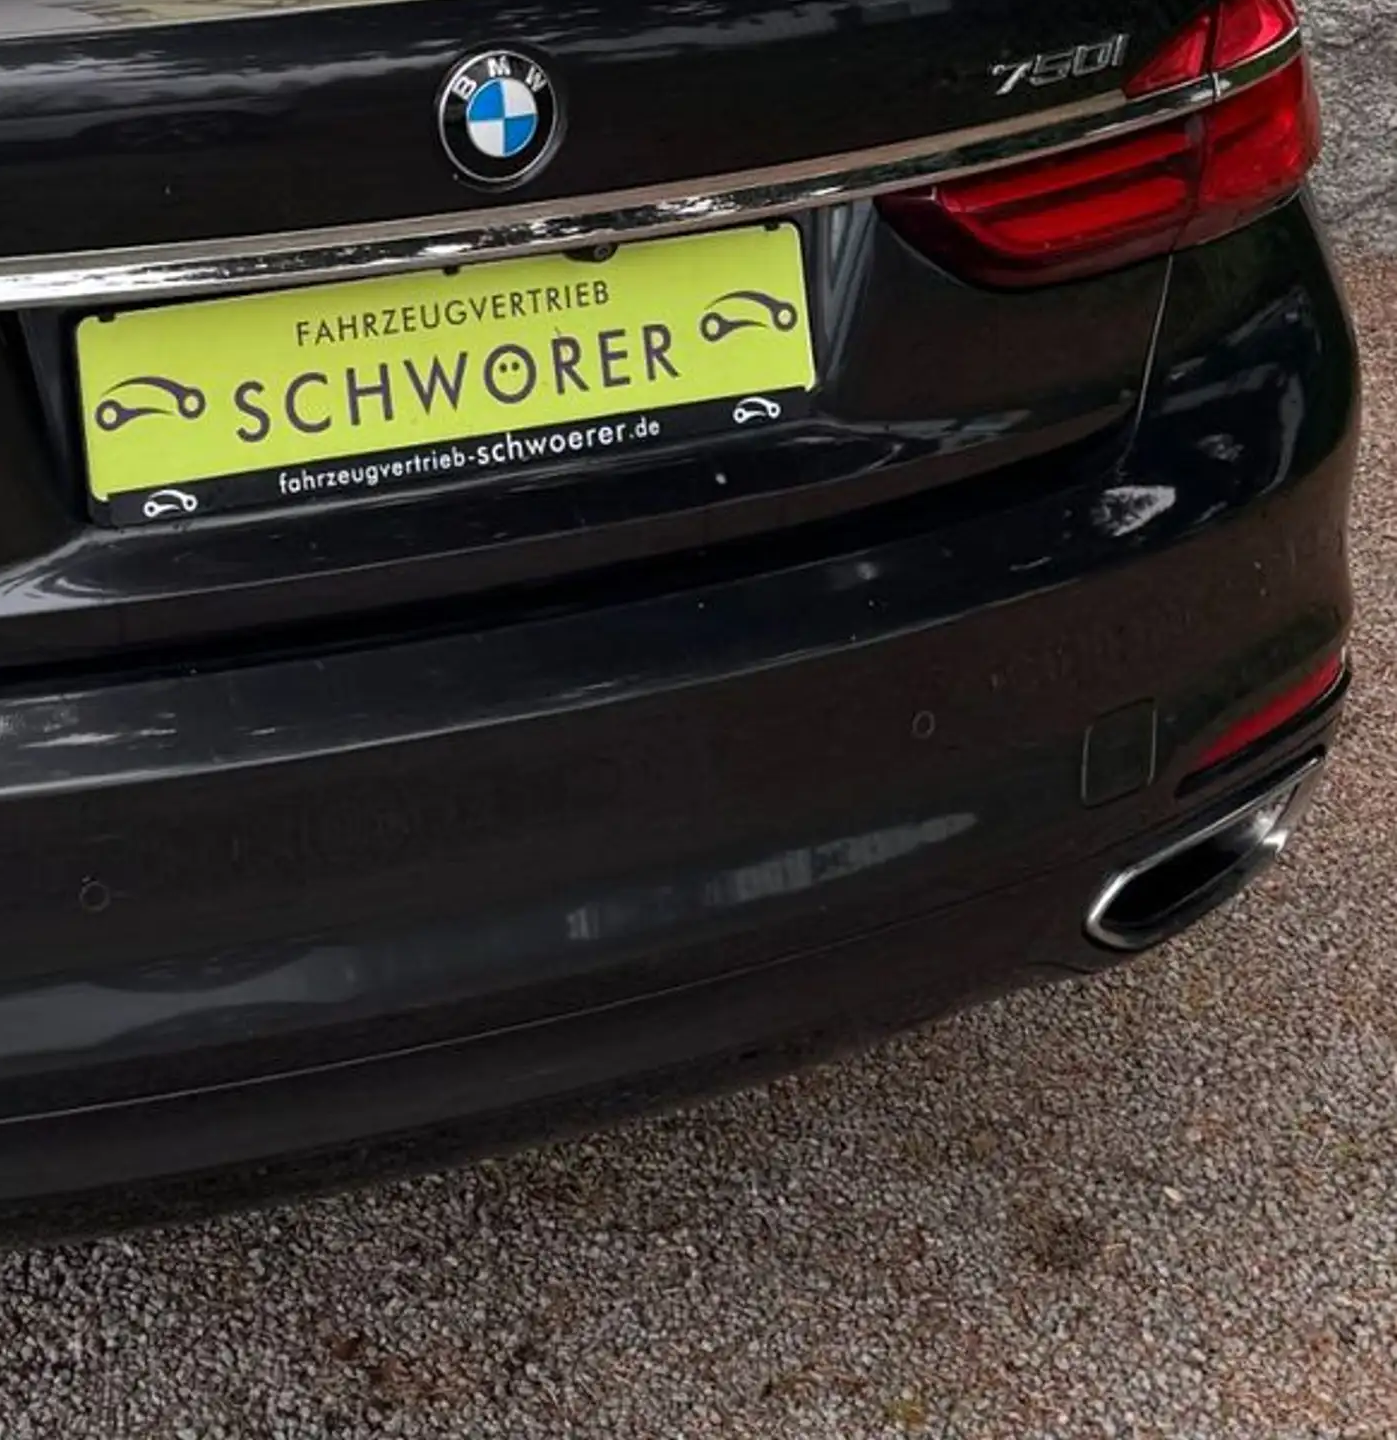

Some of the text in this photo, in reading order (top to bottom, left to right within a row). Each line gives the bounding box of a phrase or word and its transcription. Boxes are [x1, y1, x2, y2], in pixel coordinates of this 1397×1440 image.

[452, 56, 547, 100] BMW
[296, 280, 610, 346] FAHRZEUGVERTRIEB
[278, 417, 661, 494] fahrzeugvertrieb-schwoerer.de
